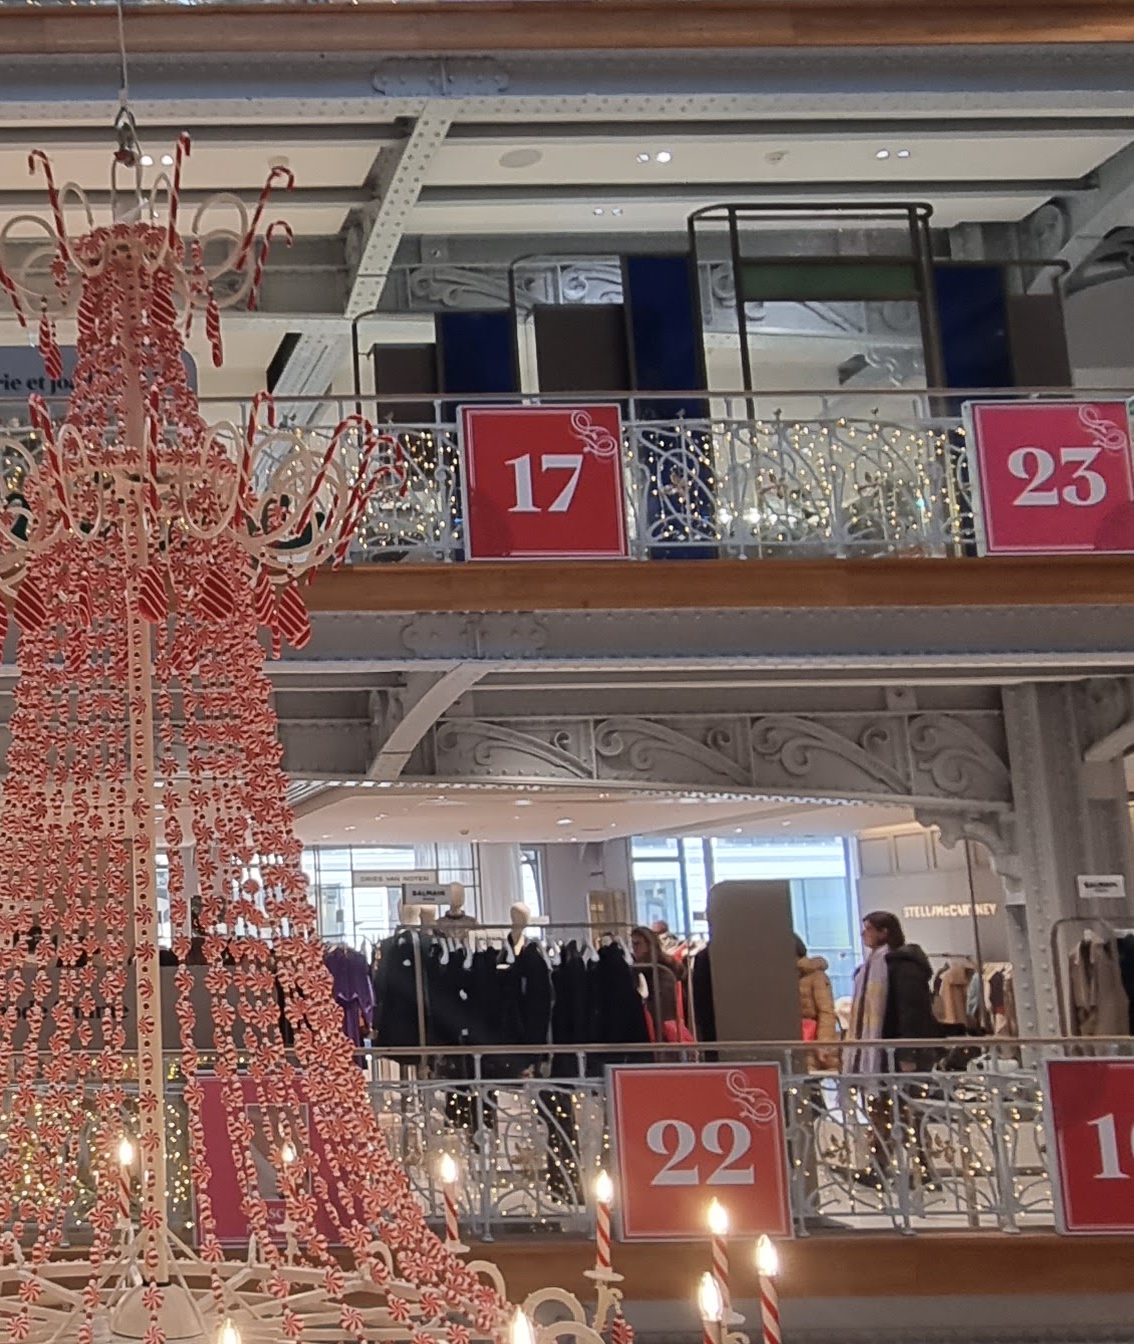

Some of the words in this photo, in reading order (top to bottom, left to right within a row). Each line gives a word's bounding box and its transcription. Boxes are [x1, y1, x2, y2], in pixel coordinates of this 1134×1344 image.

[26, 375, 45, 392] et
[505, 454, 583, 512] 17
[1008, 447, 1105, 505] 23
[647, 1119, 754, 1185] 22
[1088, 1113, 1134, 1178] 1
